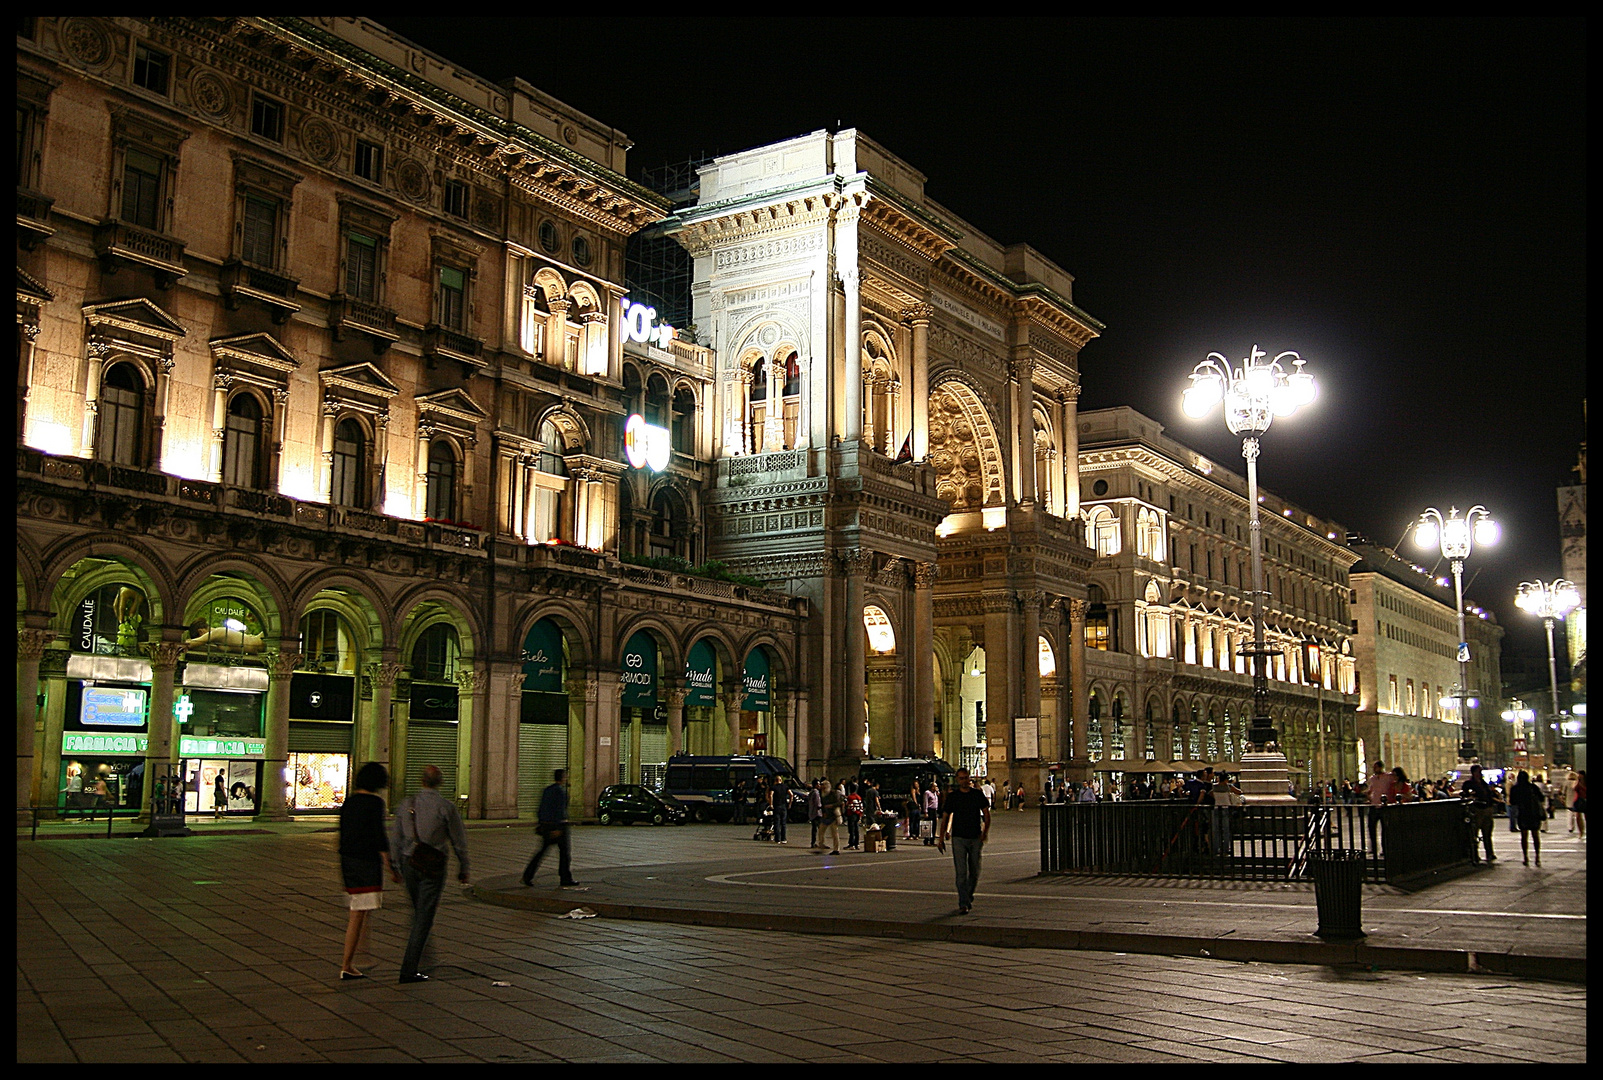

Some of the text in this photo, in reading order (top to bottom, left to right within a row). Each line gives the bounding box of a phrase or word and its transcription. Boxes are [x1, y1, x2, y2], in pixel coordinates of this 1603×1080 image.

[66, 736, 137, 752] FARMACIA
[181, 739, 246, 755] FARMACIA
[1513, 741, 1526, 750] M
